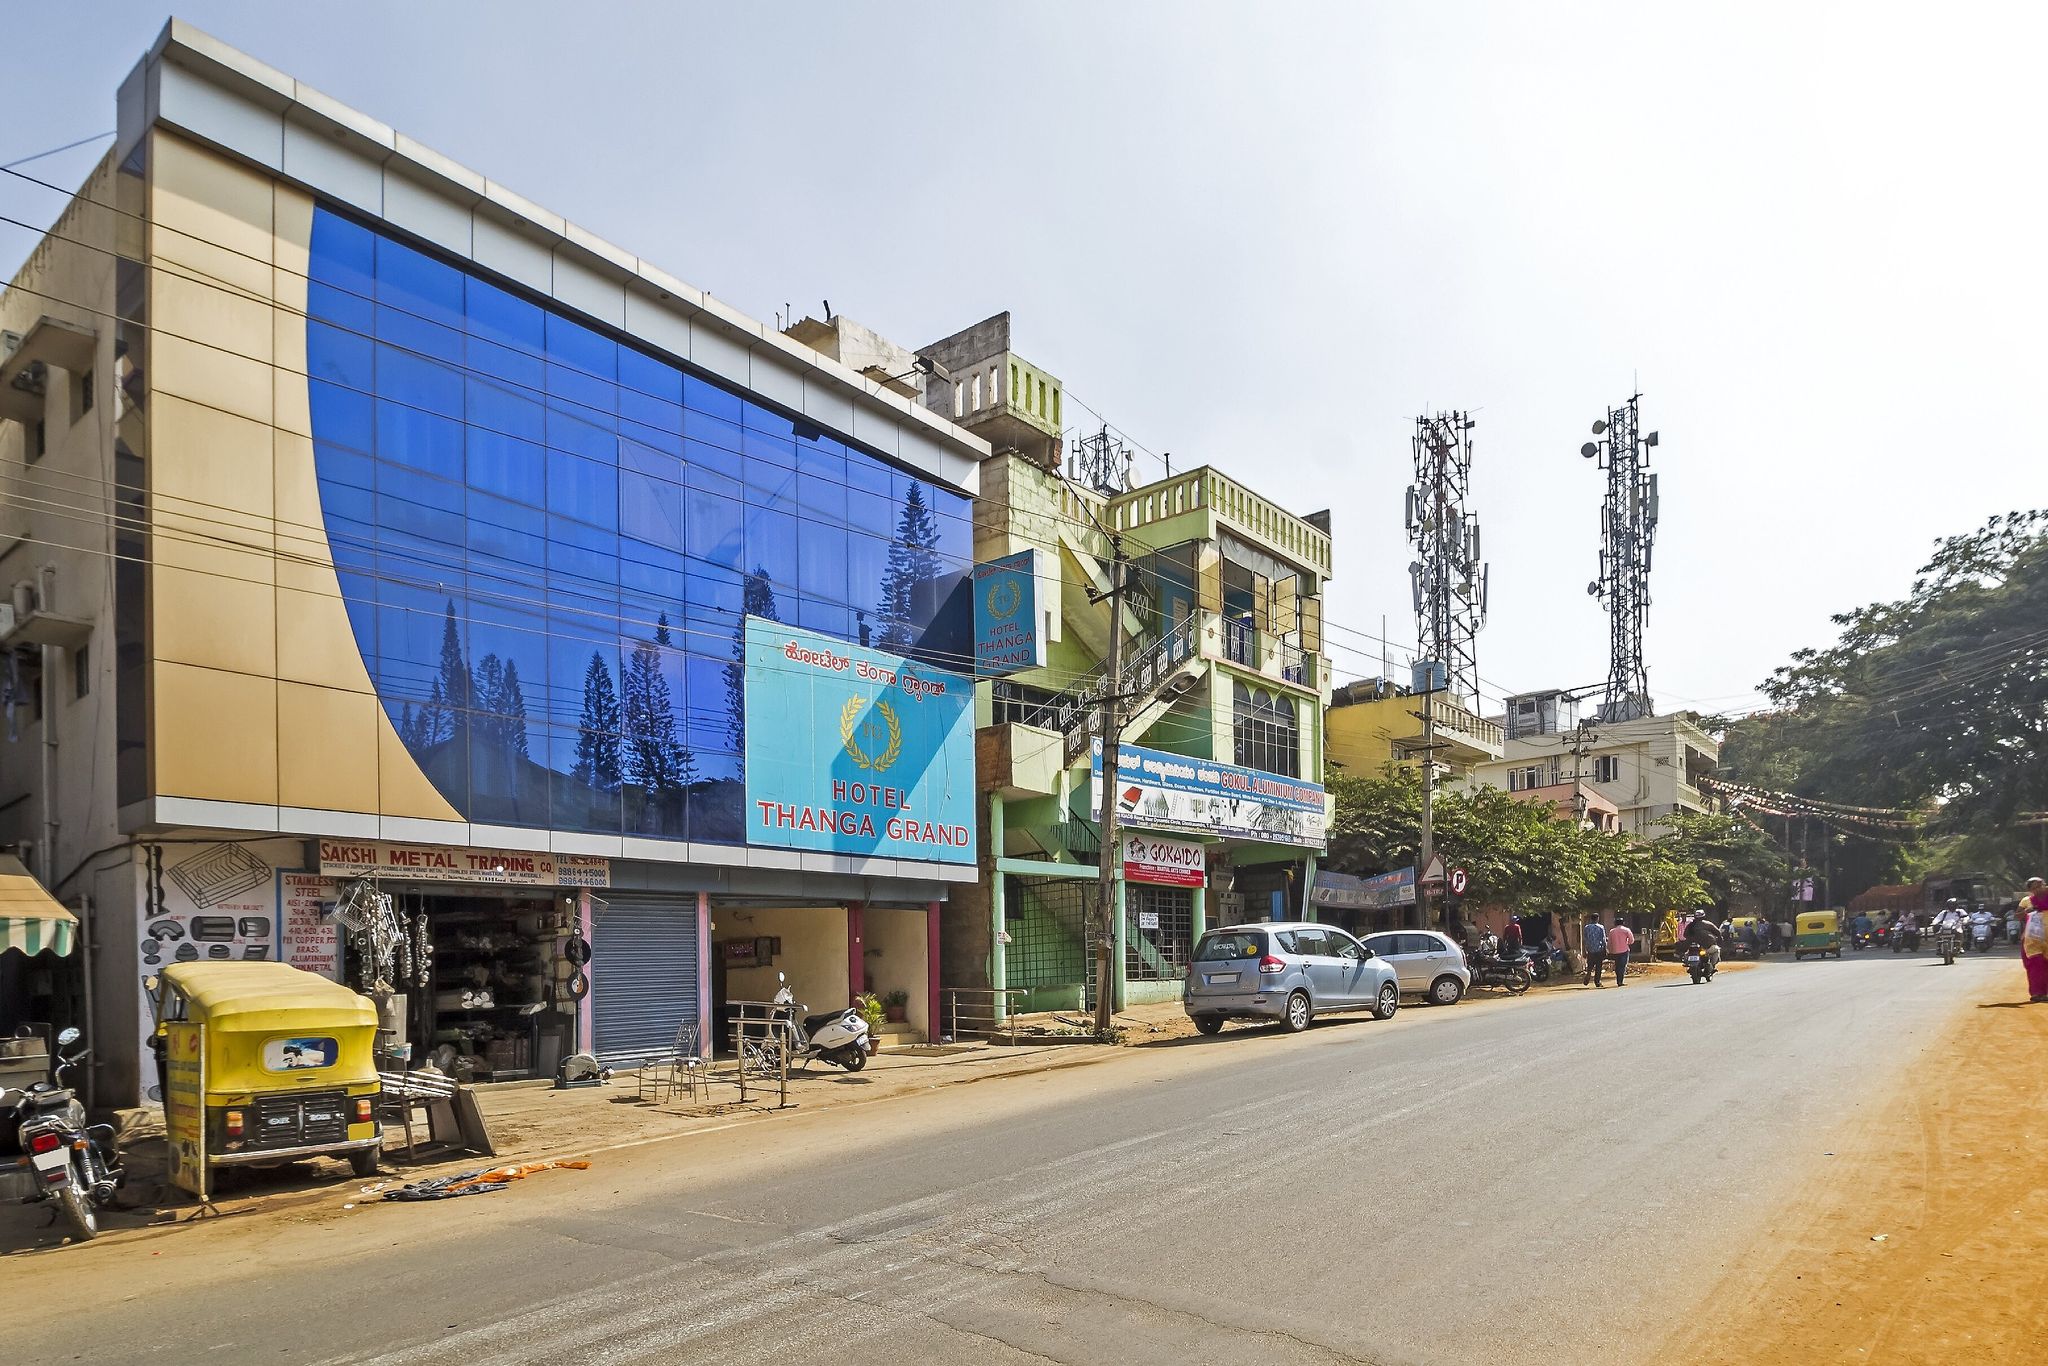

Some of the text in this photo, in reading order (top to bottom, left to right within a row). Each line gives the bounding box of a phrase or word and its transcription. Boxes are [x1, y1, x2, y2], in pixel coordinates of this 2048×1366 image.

[989, 622, 1019, 637] HOTEL
[978, 631, 1033, 655] THANGA
[784, 640, 850, 672] ಹೋಟೆಲ್
[982, 649, 1030, 671] GRAND
[832, 779, 912, 811] HOTEL
[1221, 770, 1324, 807] GOKUL ALUMINIUM COMPANY
[757, 799, 970, 848] THANGA GRAND
[320, 842, 377, 864] SAKSHI
[389, 850, 458, 868] METAL
[466, 854, 535, 873] TRADING
[1150, 843, 1201, 867] GOKAIDO
[285, 875, 335, 886] STAINLESS
[295, 888, 323, 898] STEEL
